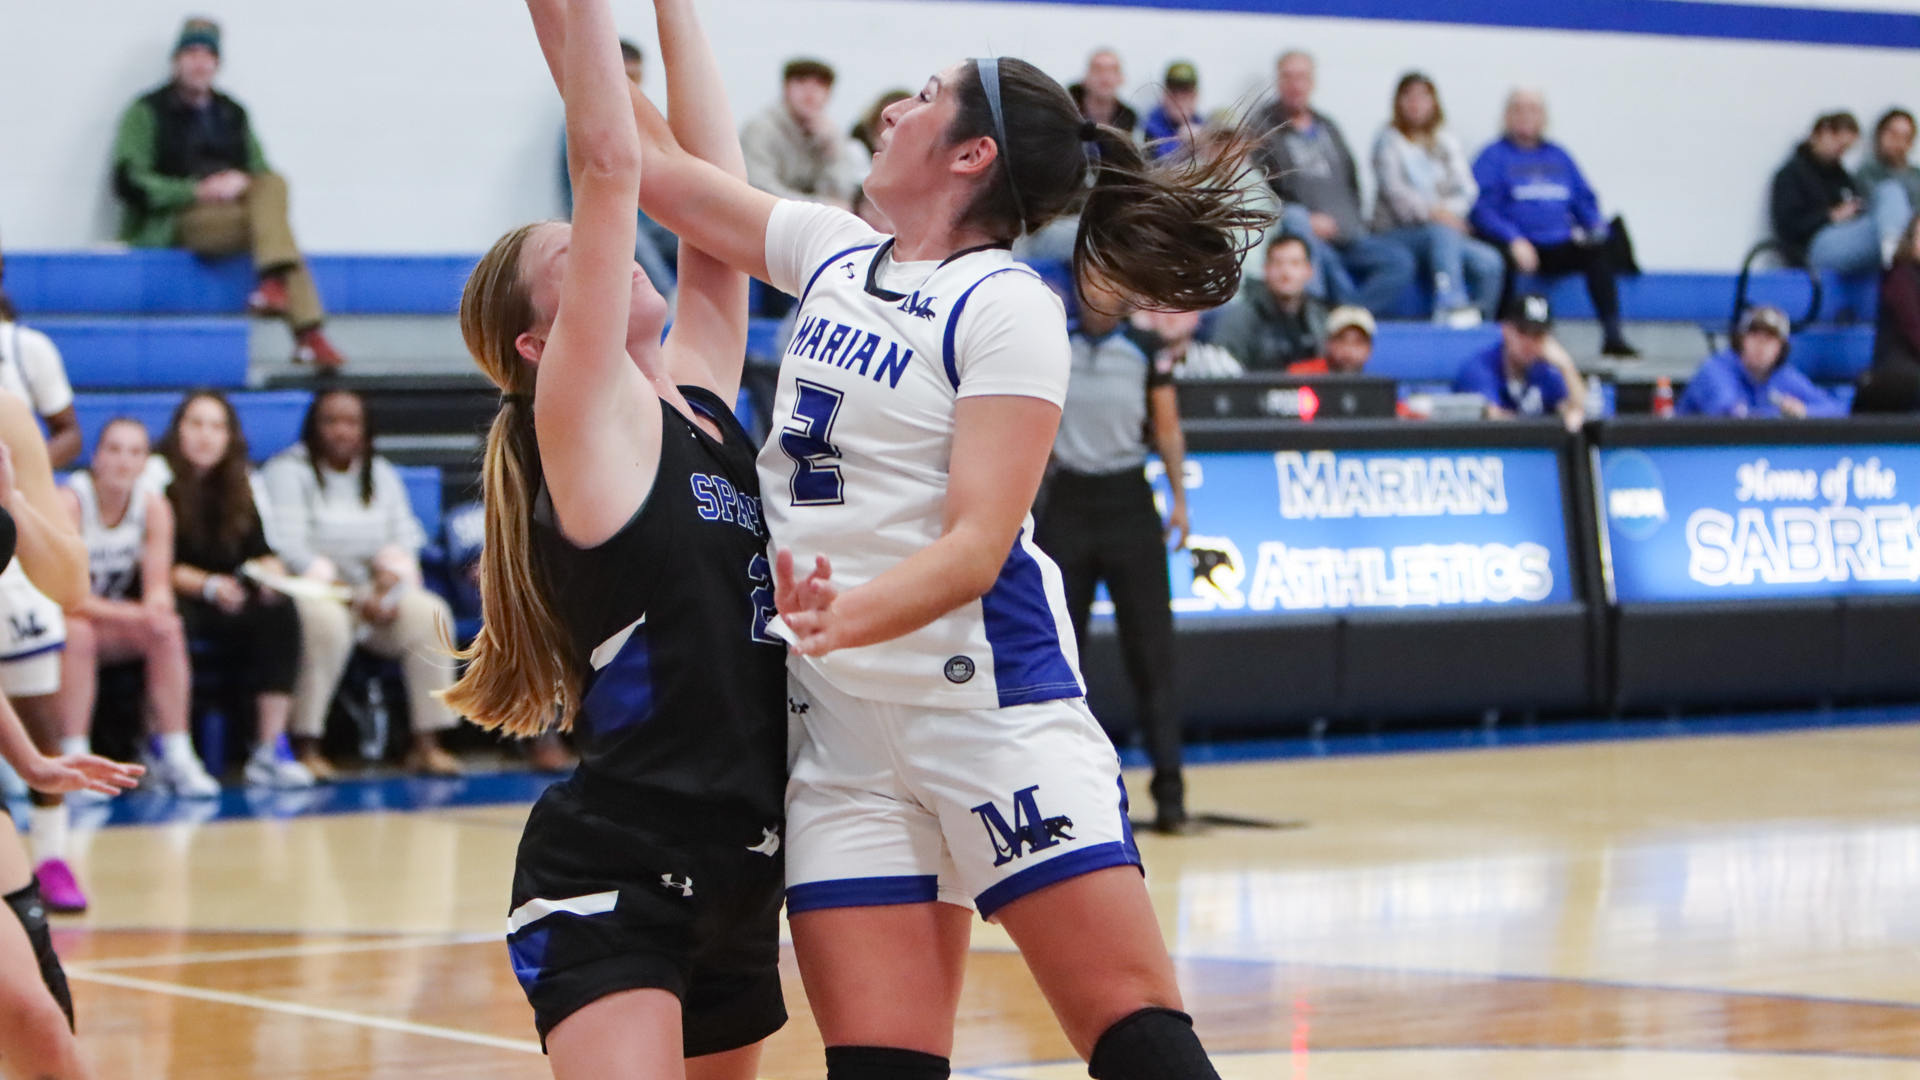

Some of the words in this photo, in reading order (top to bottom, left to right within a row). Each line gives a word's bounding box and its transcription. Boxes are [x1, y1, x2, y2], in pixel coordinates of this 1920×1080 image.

[787, 315, 914, 389] MARIAN
[778, 377, 845, 507] 2
[1820, 456, 1854, 510] of
[1853, 456, 1898, 500] the
[970, 784, 1061, 868] M
